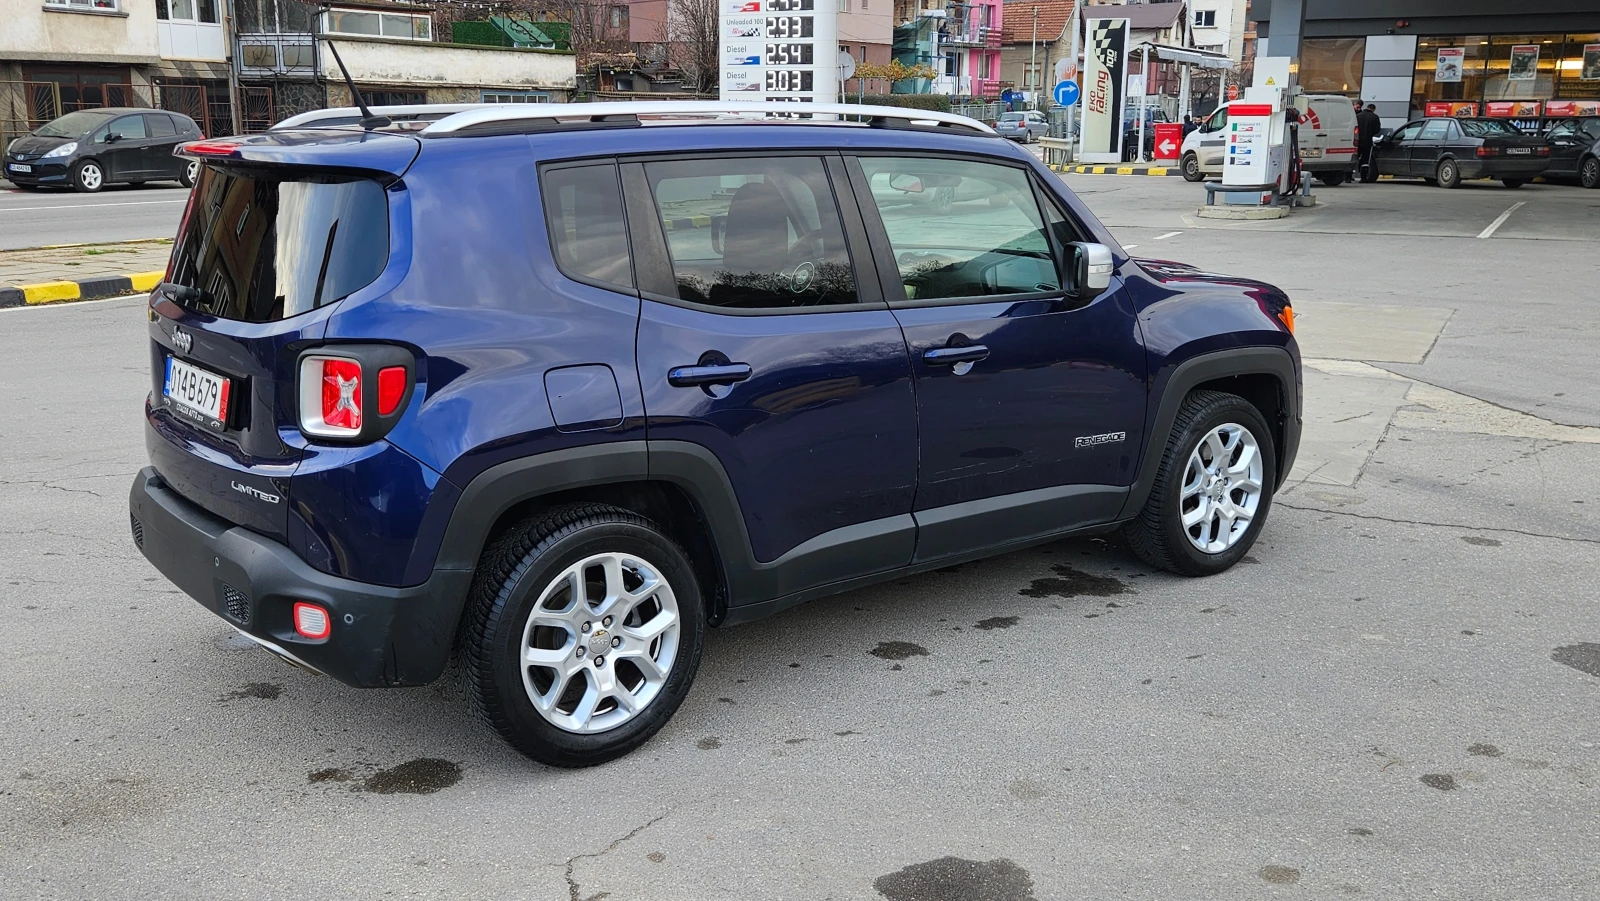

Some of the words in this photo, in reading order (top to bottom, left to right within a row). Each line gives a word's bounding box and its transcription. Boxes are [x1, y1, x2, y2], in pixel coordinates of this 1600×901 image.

[726, 18, 752, 26] Unleaded
[766, 16, 802, 38] 2.93
[726, 45, 747, 53] Diesel
[766, 43, 802, 65] 2.54
[1106, 48, 1115, 68] 100
[766, 70, 802, 92] 3.03
[1096, 69, 1109, 114] racing
[172, 325, 192, 353] Jeep
[171, 365, 218, 411] 014B679
[1075, 431, 1126, 448] RENEGADE
[231, 480, 280, 504] LIMITED
